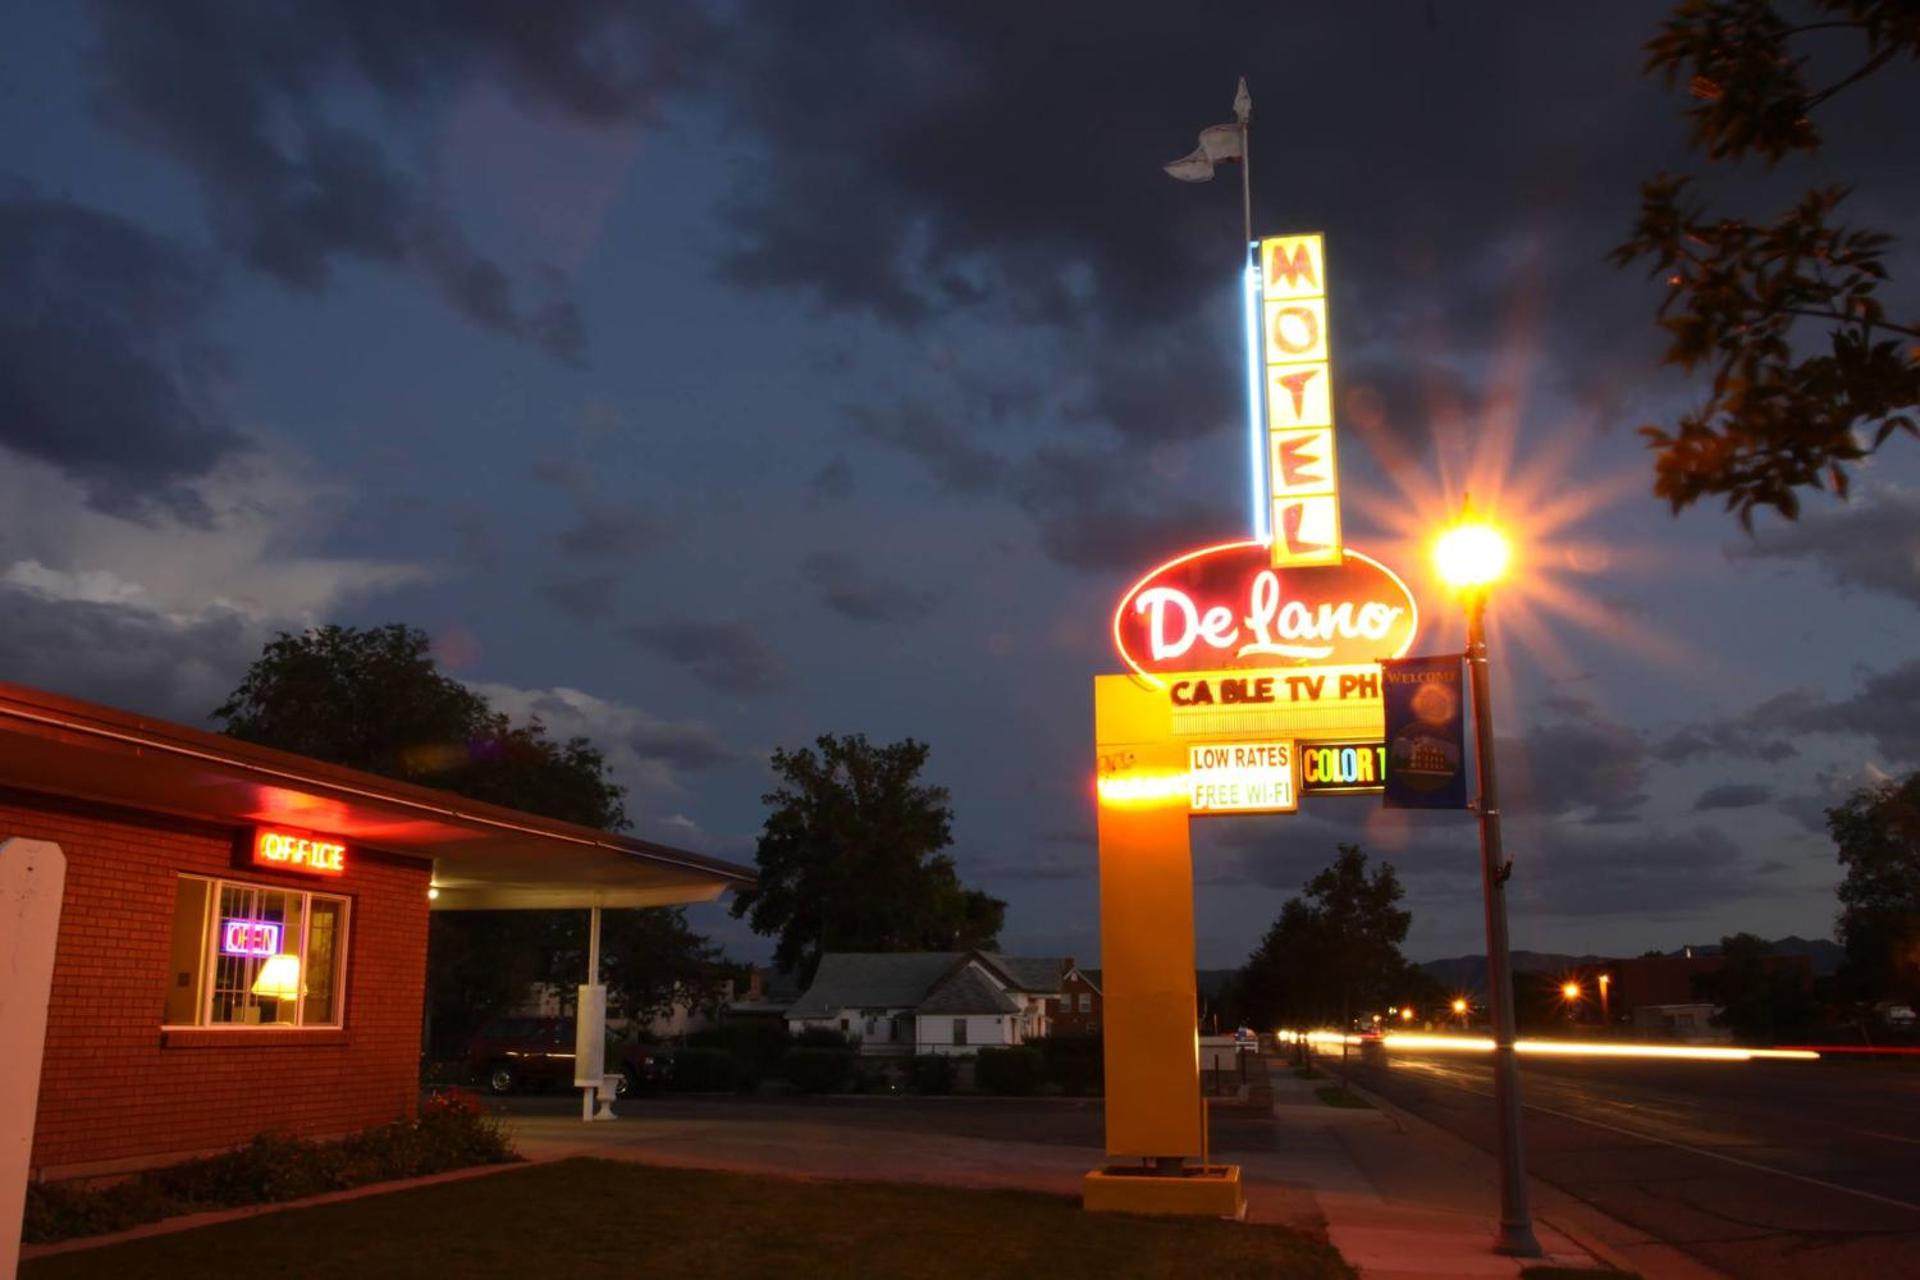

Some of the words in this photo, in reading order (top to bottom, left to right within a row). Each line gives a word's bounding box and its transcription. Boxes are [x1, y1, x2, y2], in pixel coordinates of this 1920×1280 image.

[1271, 243, 1331, 555] MOTEL
[1285, 675, 1326, 701] TV
[1194, 749, 1230, 769] LOW
[1235, 747, 1288, 768] RATES
[1304, 748, 1374, 783] COLOR
[1196, 783, 1239, 805] FREE
[1246, 782, 1290, 804] WI-FI
[262, 833, 345, 871] OFFICE
[229, 926, 274, 951] OPEN
